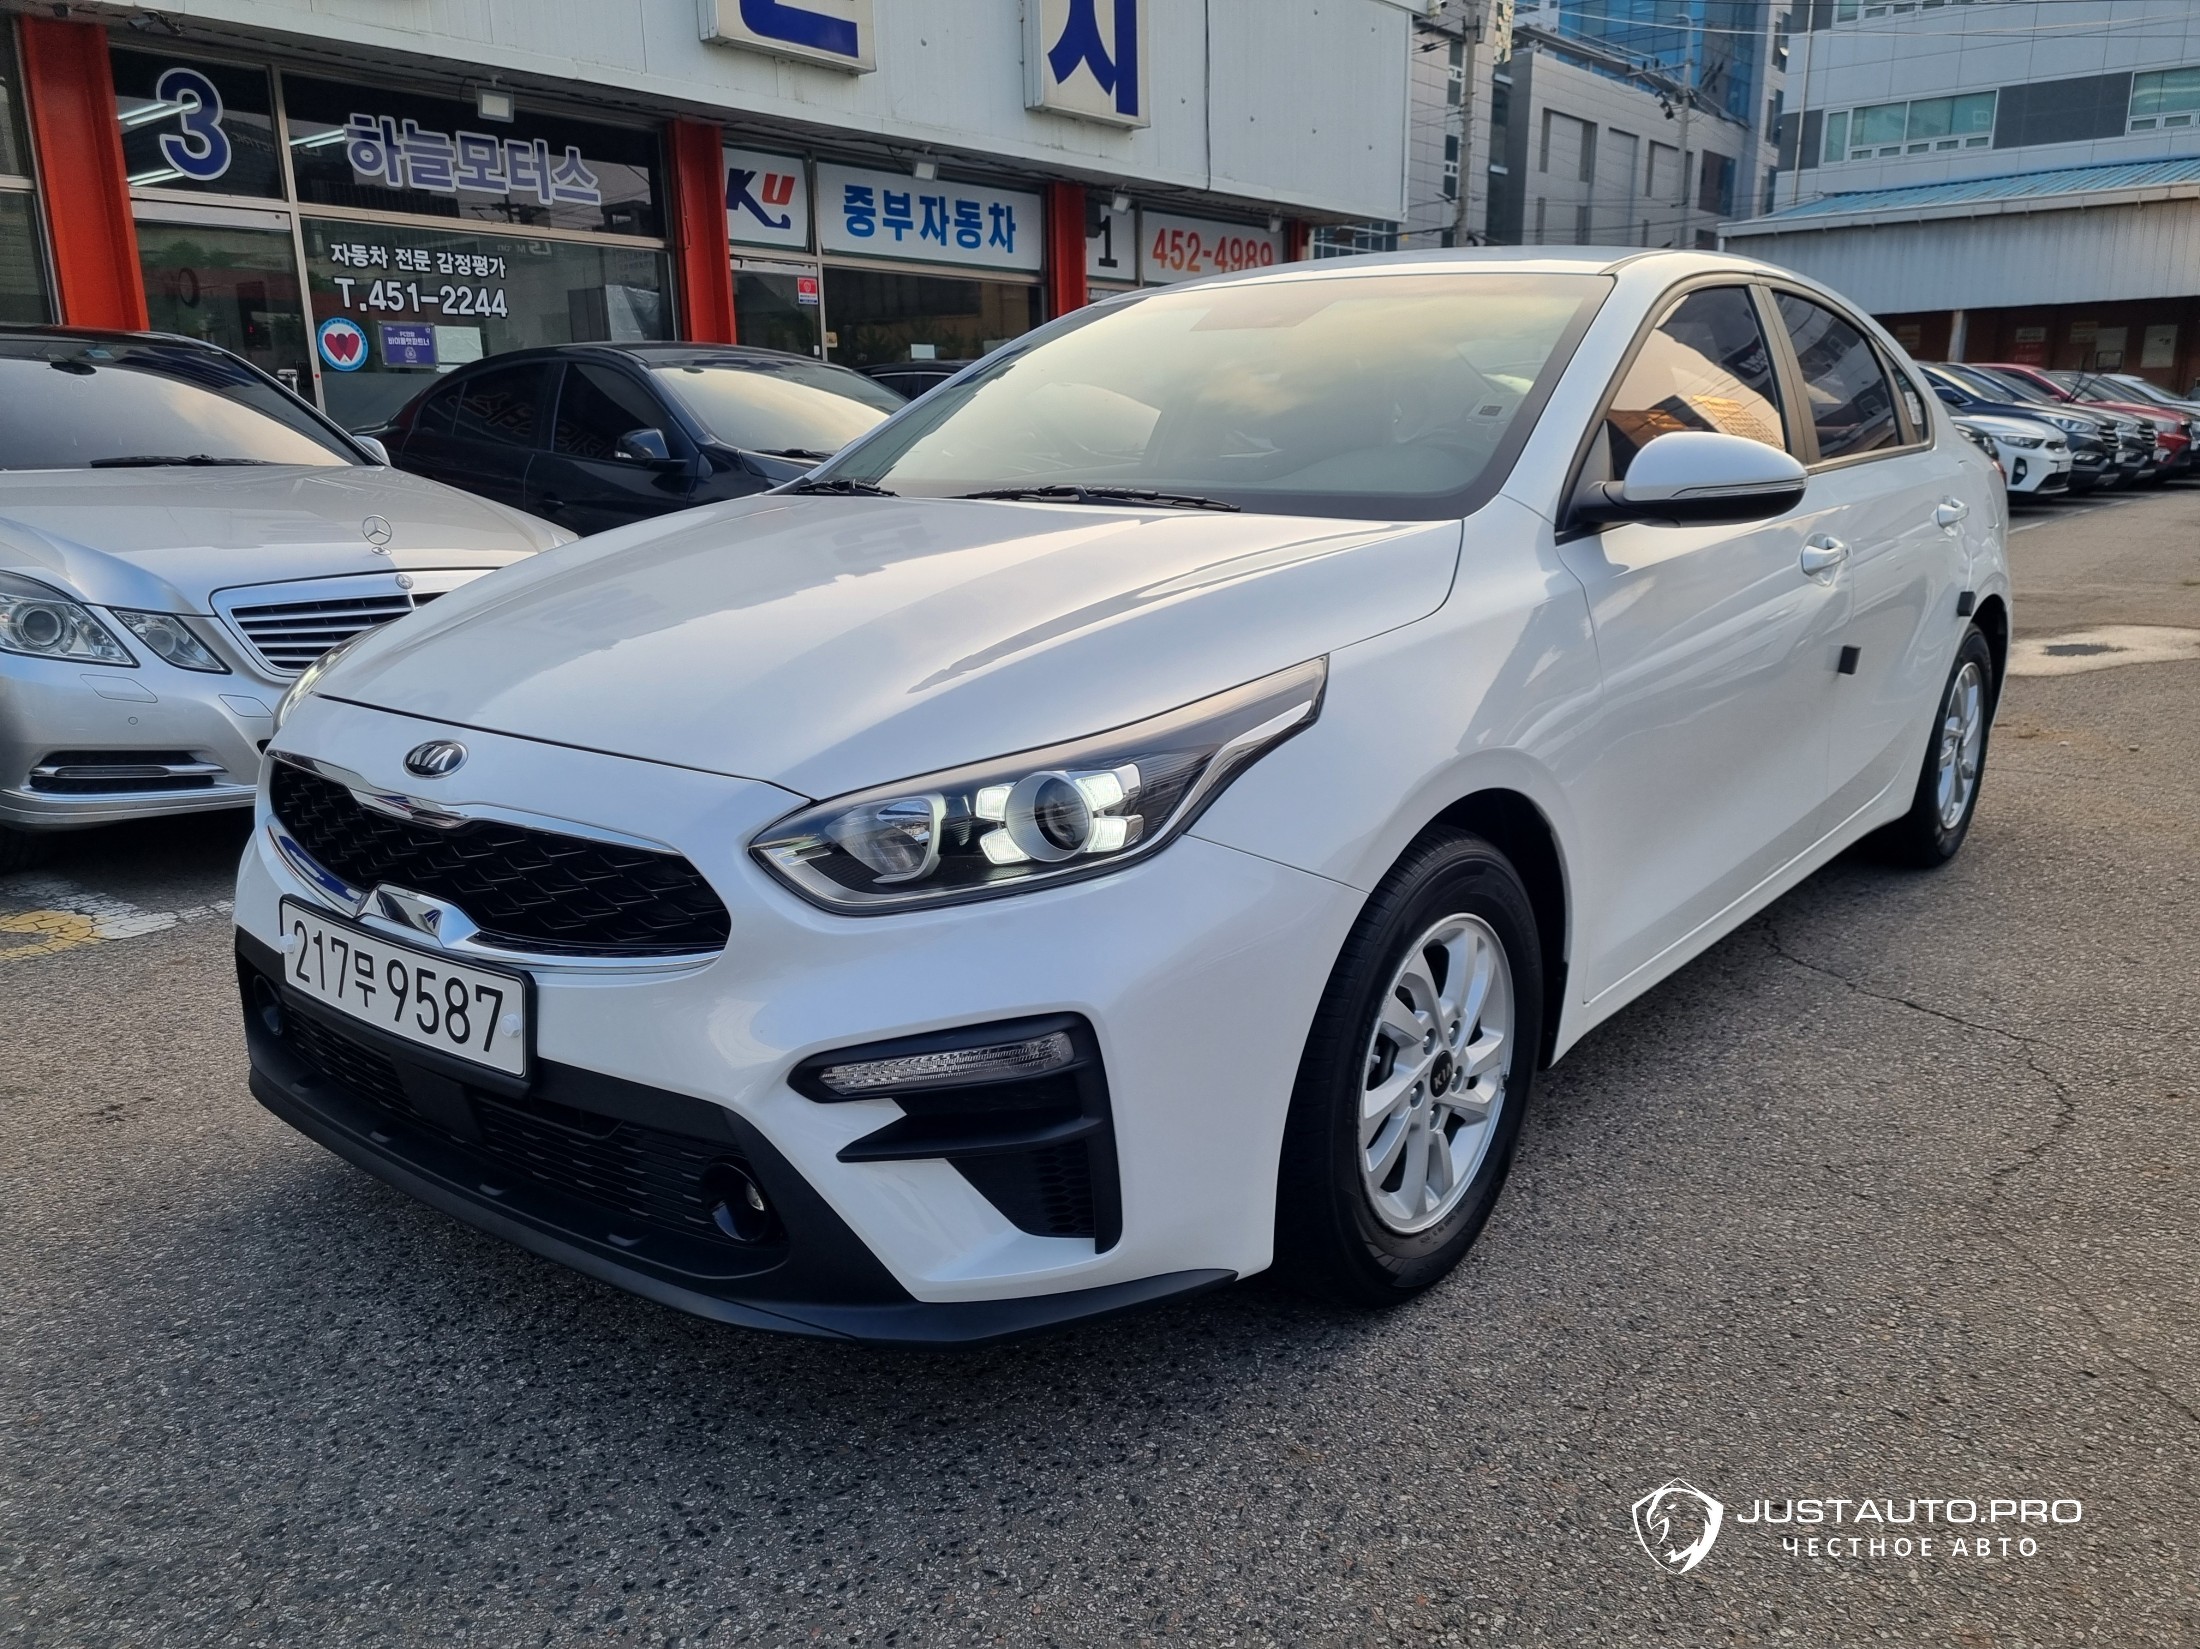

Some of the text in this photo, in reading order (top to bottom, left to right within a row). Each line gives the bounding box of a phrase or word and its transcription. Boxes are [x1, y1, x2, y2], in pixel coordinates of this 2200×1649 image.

[156, 67, 232, 181] 3
[345, 112, 600, 205] 하늘모터스
[844, 184, 1016, 253] 중부자동차
[331, 243, 506, 278] 자동차 전문 감정평가
[334, 277, 508, 318] T.451-2244
[407, 743, 455, 772] KIA
[1433, 1062, 1453, 1090] KIA
